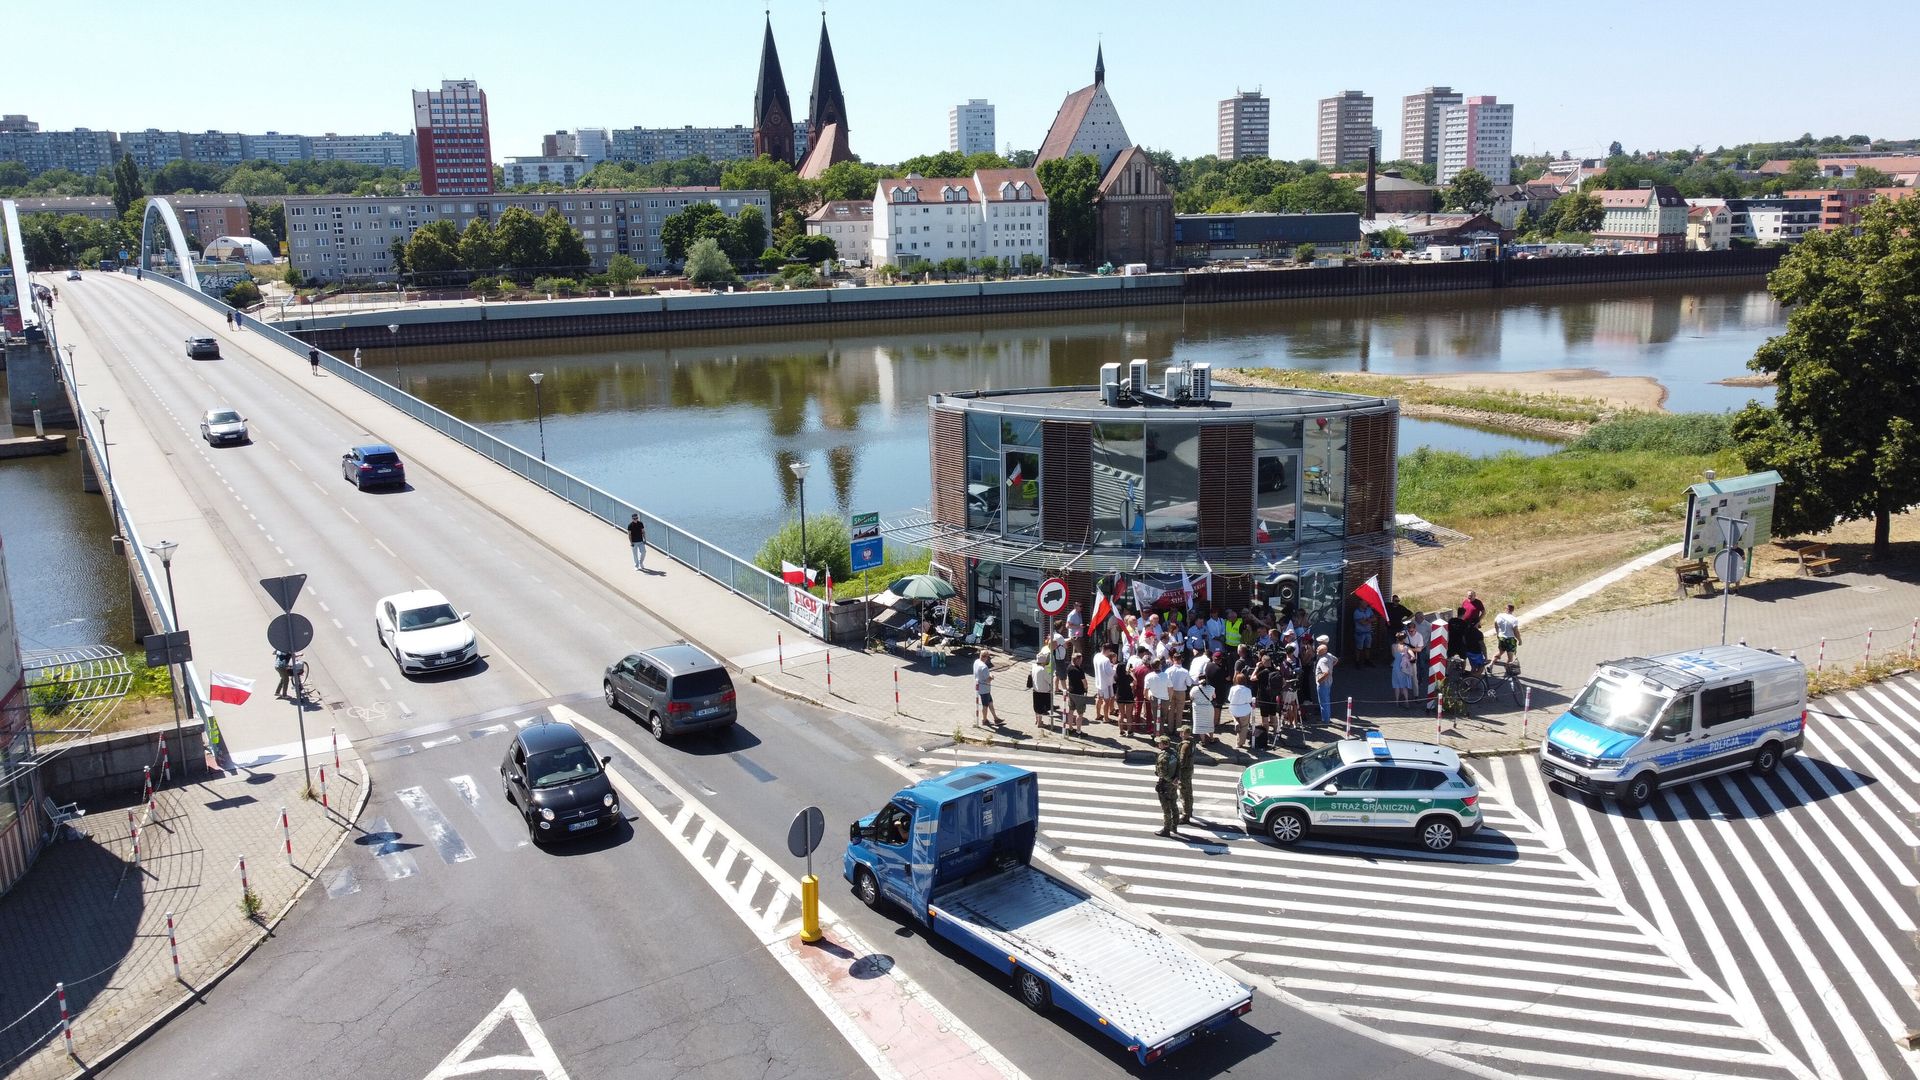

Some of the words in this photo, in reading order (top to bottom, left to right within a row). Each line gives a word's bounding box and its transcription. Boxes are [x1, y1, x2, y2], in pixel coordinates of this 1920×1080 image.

[1710, 736, 1740, 752] POLICJA
[1330, 802, 1360, 810] STRAŻ
[1362, 803, 1416, 811] GRANICZNA
